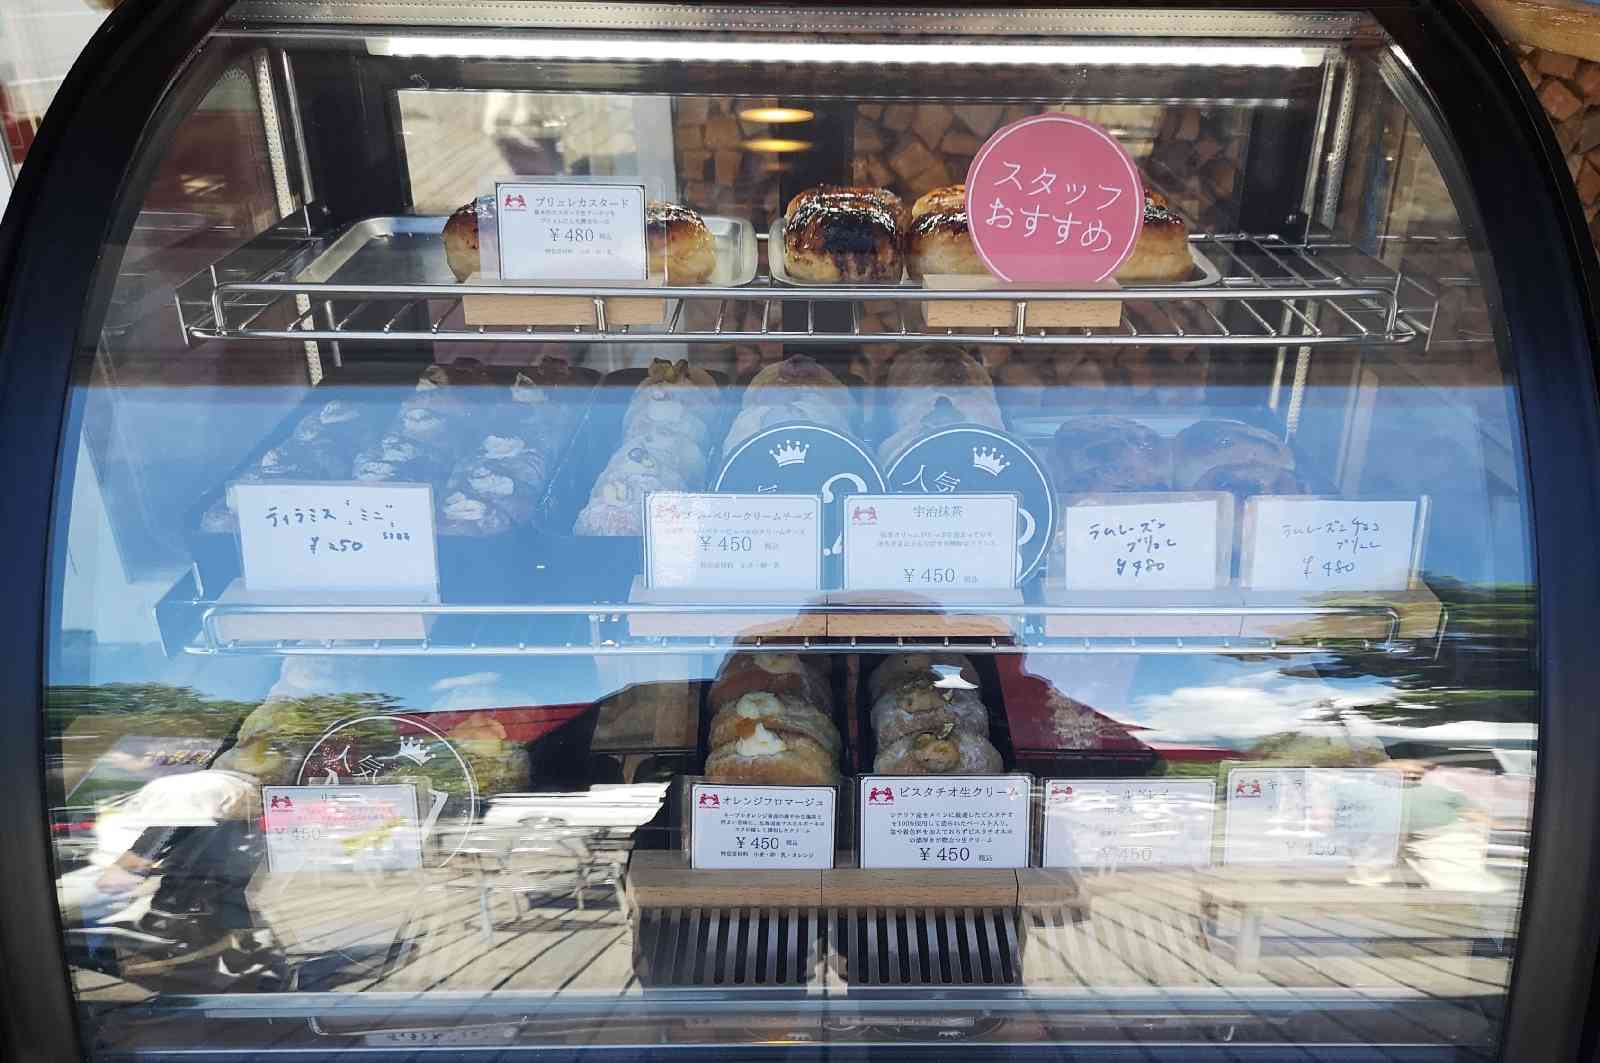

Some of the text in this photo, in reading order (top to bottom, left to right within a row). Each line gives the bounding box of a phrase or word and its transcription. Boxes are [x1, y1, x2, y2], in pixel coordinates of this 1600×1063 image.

[994, 161, 1122, 210] スタッフ
[986, 197, 1112, 252] おすすめ
[265, 506, 337, 527] ティラミス
[722, 796, 824, 806] オレンジフロマージュ
